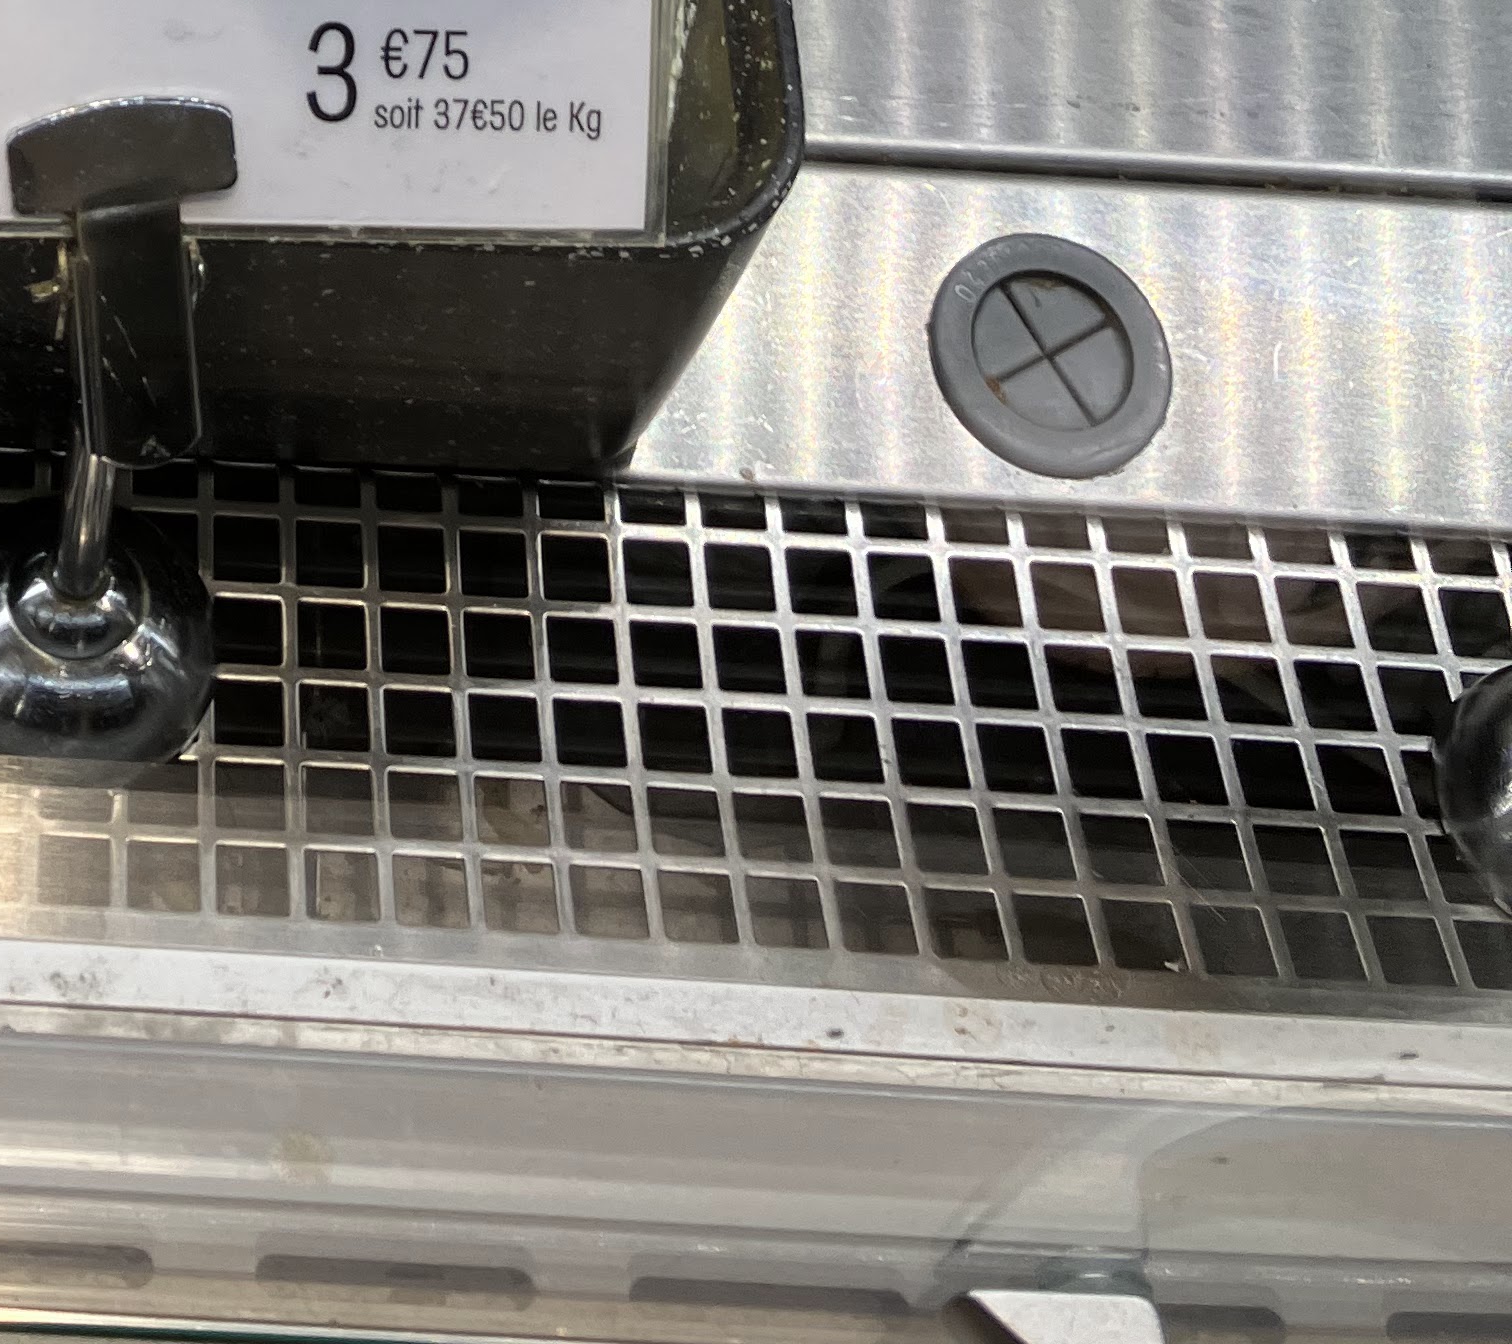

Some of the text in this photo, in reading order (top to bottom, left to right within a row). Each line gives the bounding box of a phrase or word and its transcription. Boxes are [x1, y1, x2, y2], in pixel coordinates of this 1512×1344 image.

[306, 21, 470, 123] 3 €75
[374, 97, 603, 141] soit 37€50 le Kg
